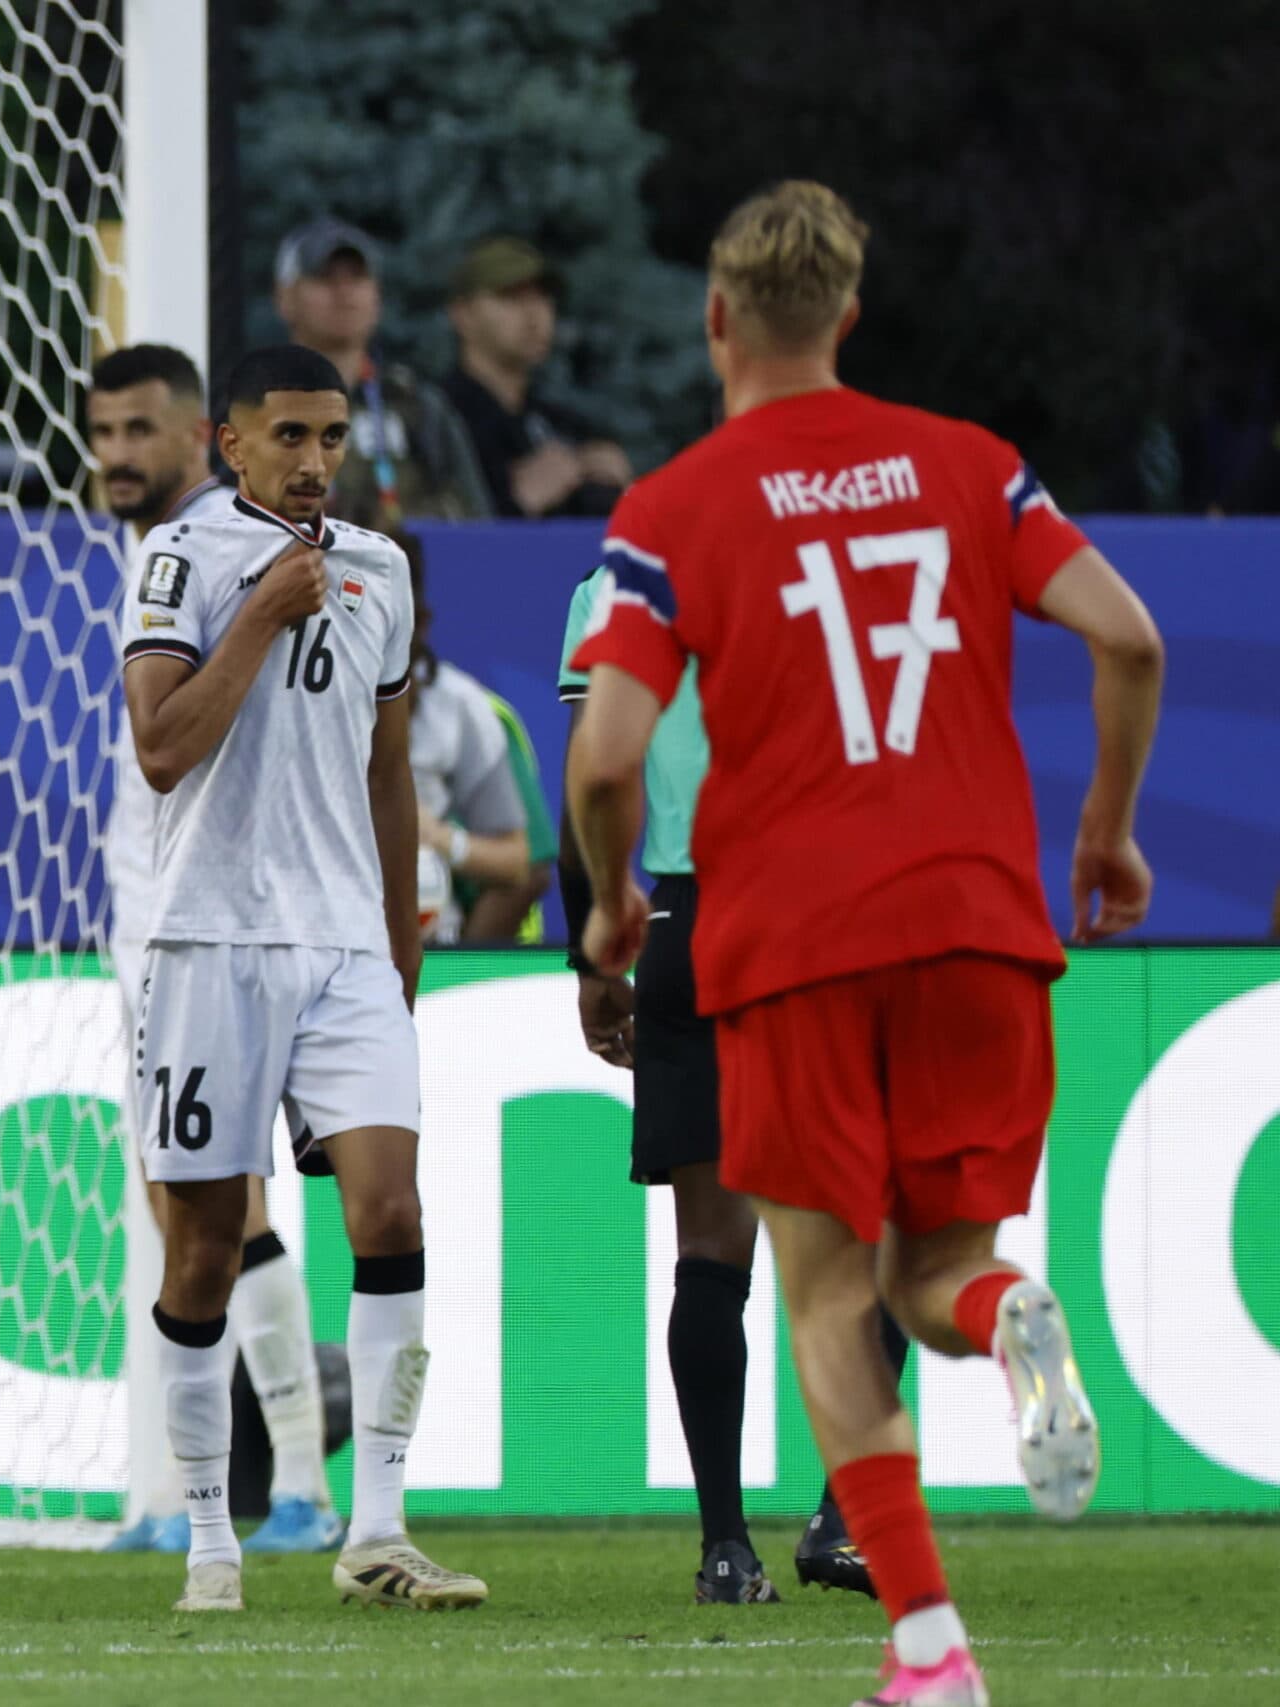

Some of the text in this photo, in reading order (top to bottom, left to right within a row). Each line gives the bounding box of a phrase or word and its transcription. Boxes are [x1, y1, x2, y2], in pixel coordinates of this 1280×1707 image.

[759, 454, 921, 520] HEGGEM
[286, 616, 334, 694] 16
[780, 526, 961, 765] 17
[155, 1065, 213, 1152] 16
[384, 1451, 407, 1465] JA
